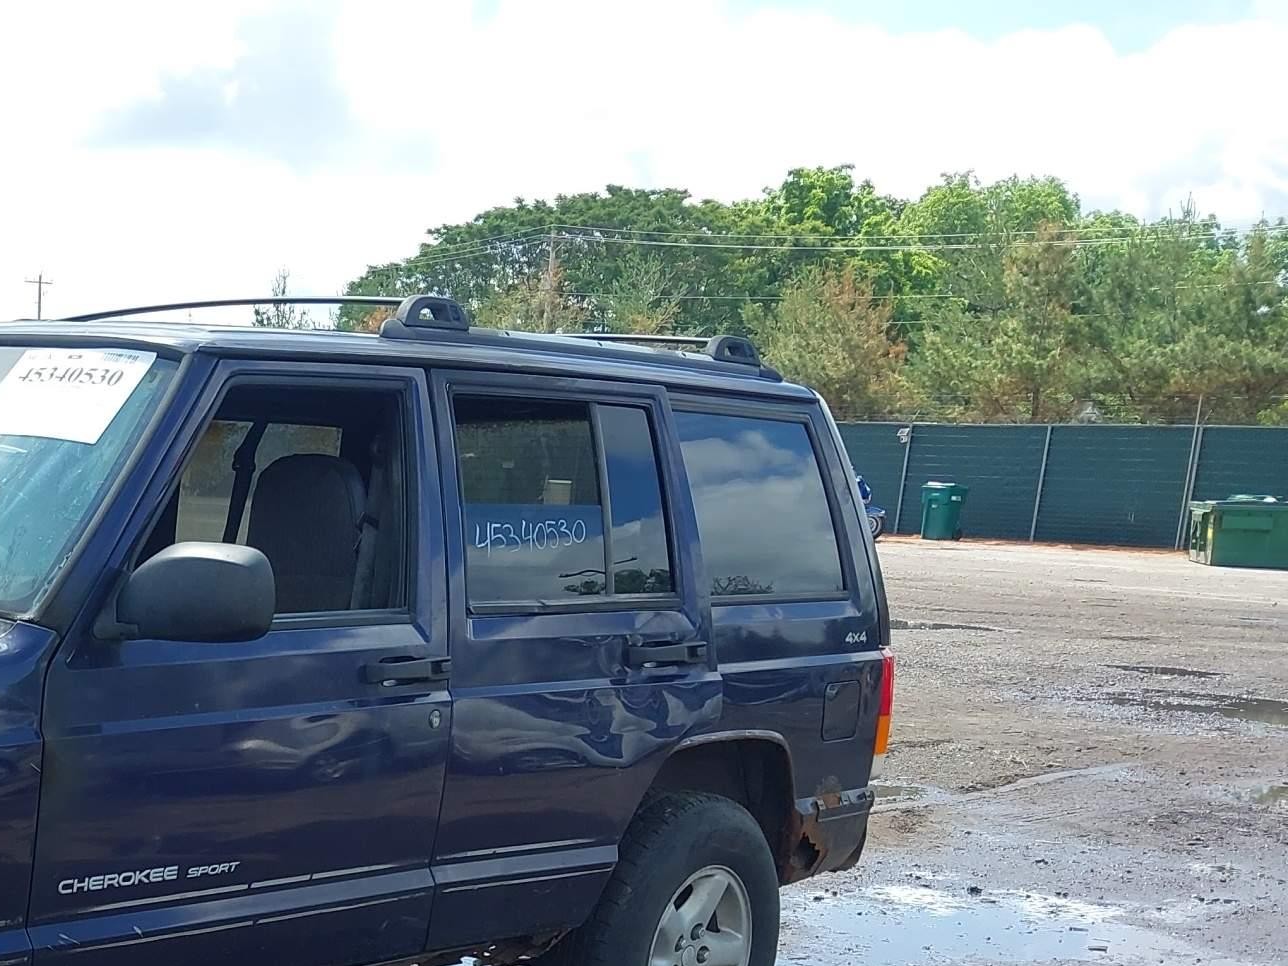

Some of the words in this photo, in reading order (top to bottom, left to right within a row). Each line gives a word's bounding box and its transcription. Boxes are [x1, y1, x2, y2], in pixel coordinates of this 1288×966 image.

[18, 367, 124, 386] 45340530
[475, 519, 586, 558] 45340530
[57, 865, 179, 894] CHEROKEE
[186, 861, 241, 878] SPORT
